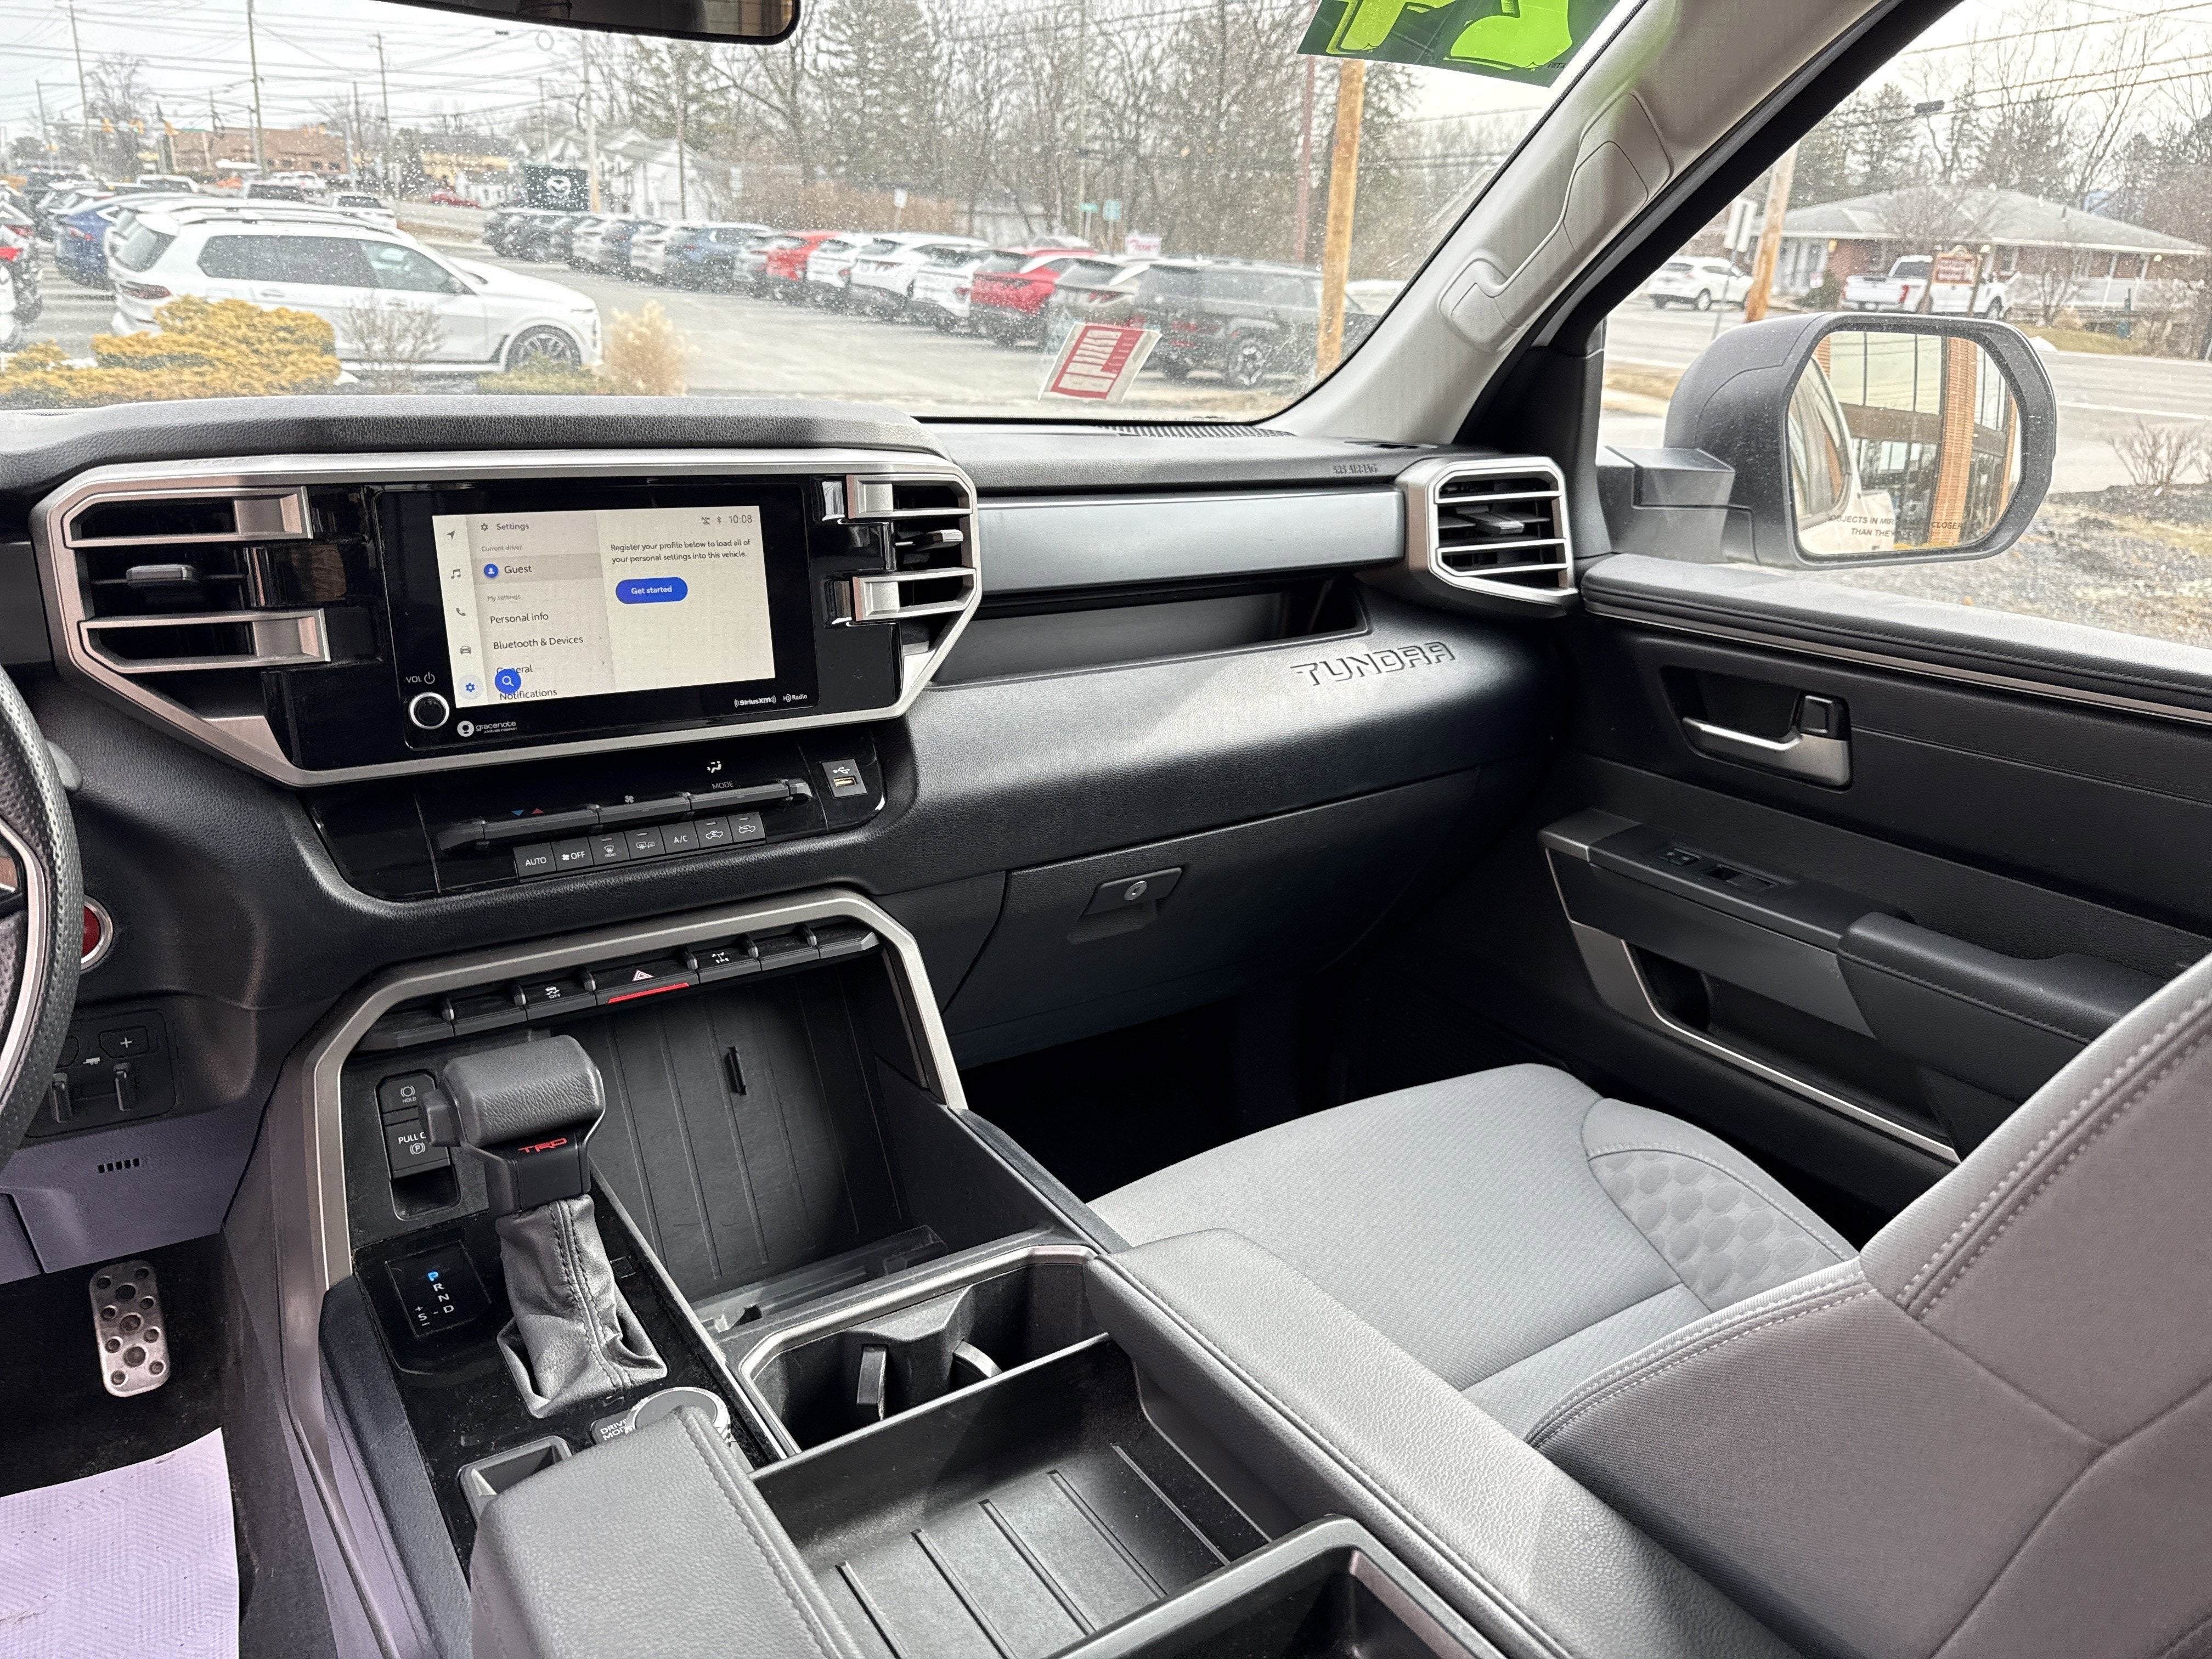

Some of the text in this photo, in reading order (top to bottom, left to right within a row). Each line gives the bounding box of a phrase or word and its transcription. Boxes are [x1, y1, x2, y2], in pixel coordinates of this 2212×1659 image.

[729, 515, 753, 524] 10:08
[496, 522, 529, 531] Settings
[611, 544, 640, 552] Register
[659, 541, 683, 550] profile
[611, 556, 628, 565] your
[630, 554, 662, 563] personal
[663, 552, 691, 561] settings
[504, 565, 533, 574] Guest
[646, 585, 673, 594] started
[490, 612, 549, 624] Personal info
[493, 636, 584, 650] Bluetooth & Devices
[1290, 641, 1455, 686] TUNDRA
[496, 664, 533, 674] Geral
[406, 675, 422, 684] VOL
[500, 689, 557, 701] Notifications
[476, 721, 517, 731] gracenote
[712, 781, 734, 790] MODE
[674, 835, 688, 844] A/C
[571, 851, 586, 860] OFF
[525, 856, 548, 867] AUTO
[398, 1133, 419, 1144] PULL
[518, 1137, 568, 1153] TRD
[428, 1271, 438, 1282] P
[433, 1283, 444, 1291] R
[438, 1293, 450, 1302] N
[443, 1305, 454, 1313] D
[418, 1313, 427, 1321] S
